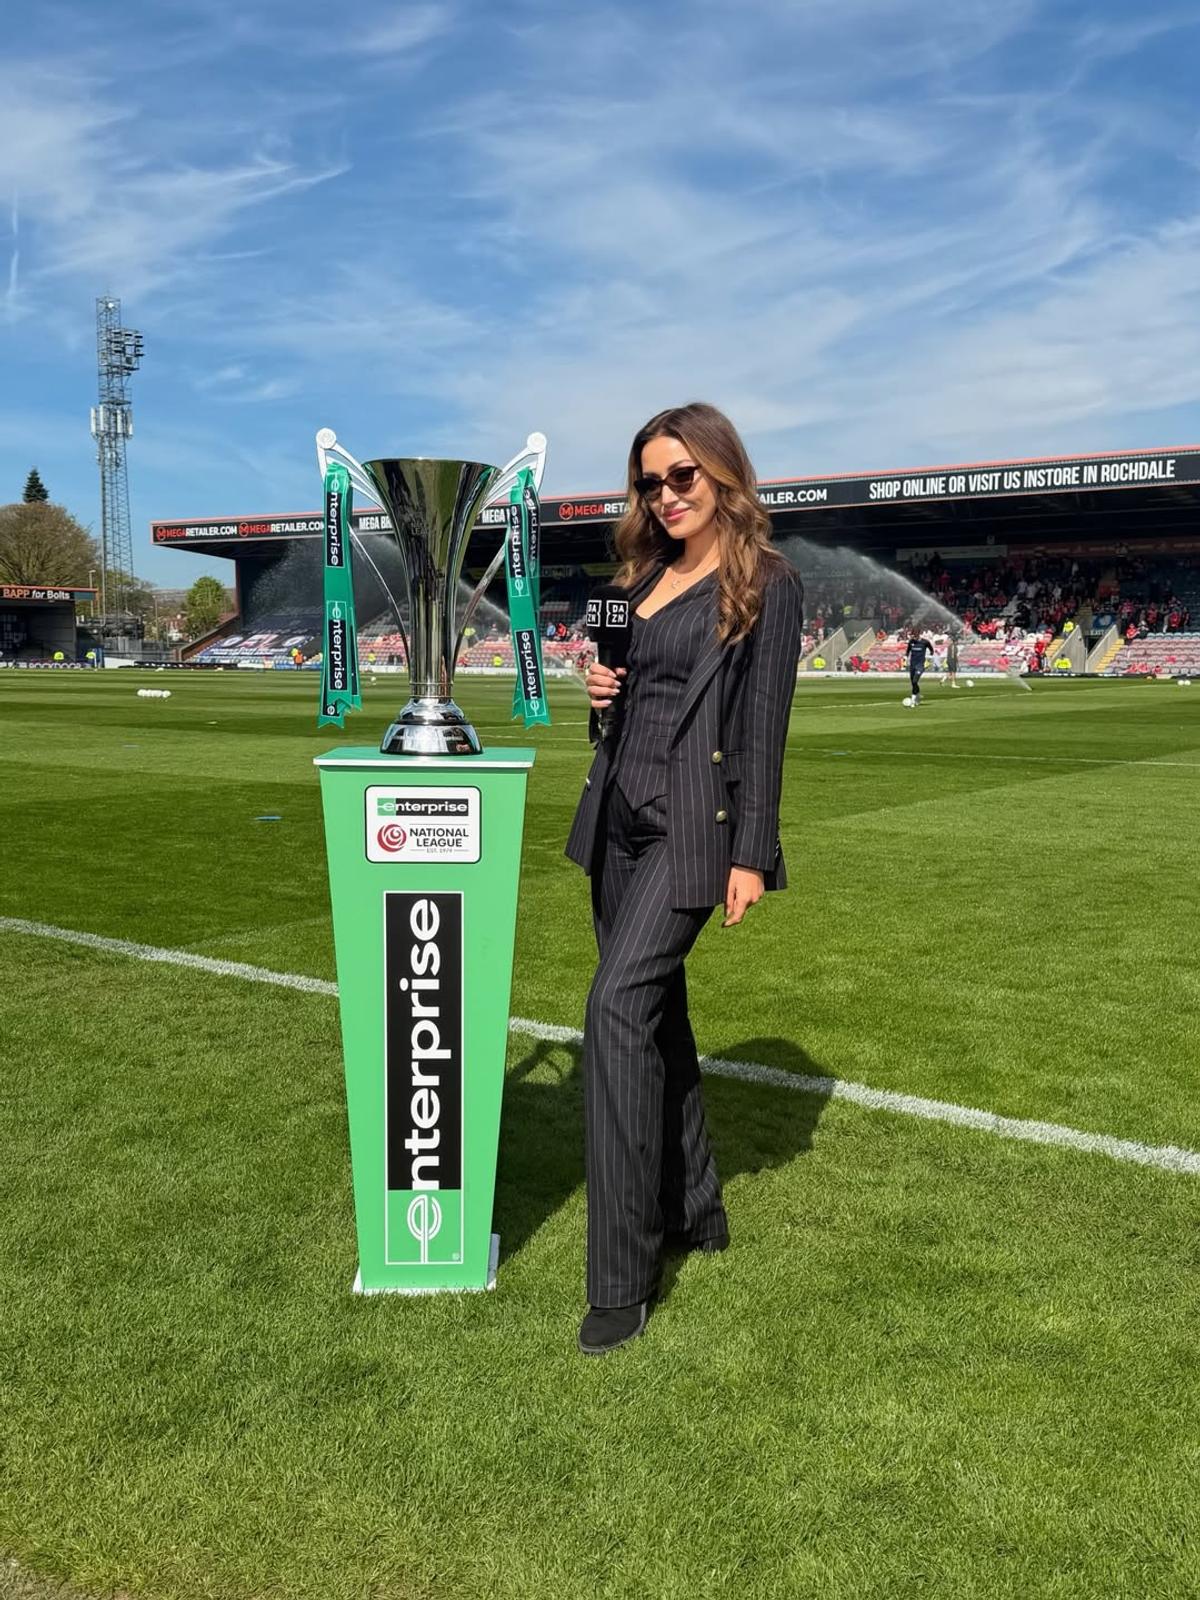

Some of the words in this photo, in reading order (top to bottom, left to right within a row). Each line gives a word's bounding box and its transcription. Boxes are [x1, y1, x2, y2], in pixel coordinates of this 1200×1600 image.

[869, 481, 901, 499] SHOP
[903, 477, 946, 496] ONLINE
[948, 475, 966, 493] OR
[968, 473, 1002, 492] VISIT
[1004, 471, 1021, 489] US
[1023, 466, 1080, 488] INSTORE
[1083, 465, 1098, 483] IN
[1101, 460, 1176, 482] ROCHDALE
[328, 473, 341, 566] enterprise
[359, 516, 380, 530] MEGA
[481, 508, 506, 523] MEGA
[167, 526, 238, 537] MEGARETAILER.COM
[511, 505, 524, 594] enterprise
[3, 588, 30, 599] BAPP
[32, 590, 45, 599] for
[47, 590, 70, 599] Bolts
[331, 603, 345, 689] enterprise
[521, 631, 540, 714] enterprise
[378, 801, 467, 814] enterprise
[410, 828, 469, 837] NATIONAL
[417, 838, 462, 847] LEAGUE
[399, 898, 452, 1262] enterprise
